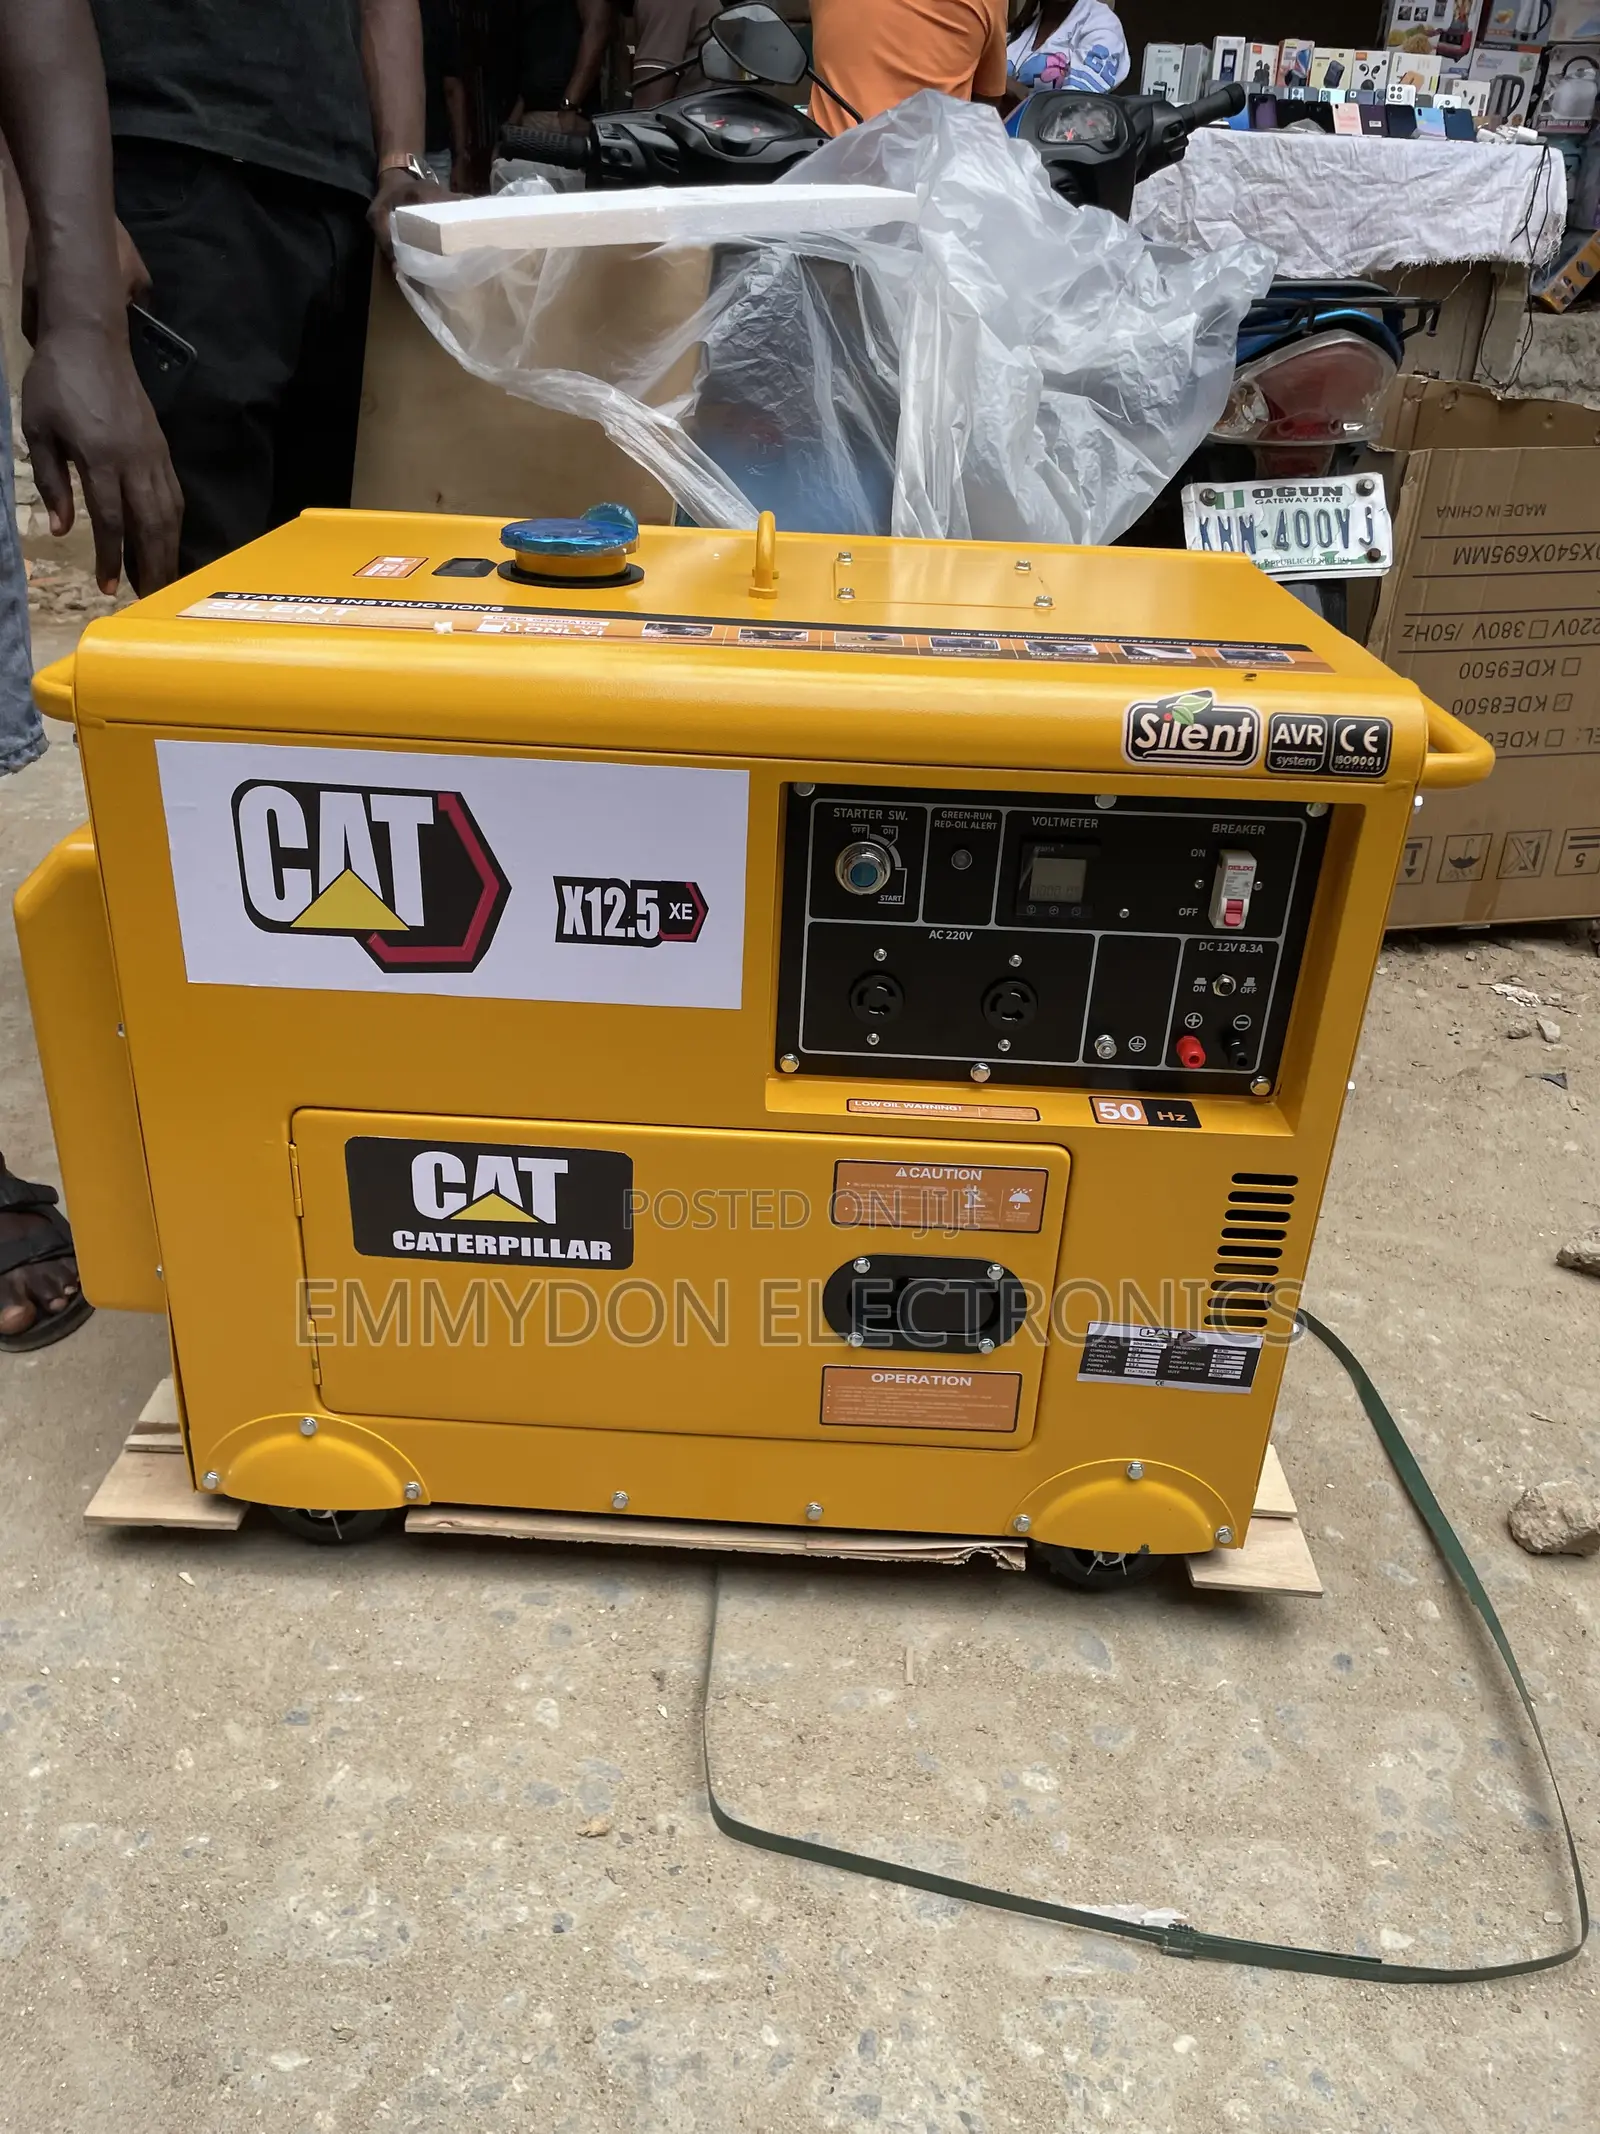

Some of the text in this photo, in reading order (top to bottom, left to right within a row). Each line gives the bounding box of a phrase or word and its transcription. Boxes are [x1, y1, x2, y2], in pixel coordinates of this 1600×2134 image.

[1252, 486, 1343, 498] OGUN
[1254, 496, 1342, 505] GATEWAY STATE
[1436, 504, 1547, 518] MADE IN CHINA
[206, 601, 361, 617] SILENT
[224, 593, 504, 612] STARTING INSTRUCTIONS
[523, 626, 604, 636] ONLY!
[1402, 621, 1464, 643] /50Hz
[1472, 620, 1524, 641] 380V
[1459, 658, 1556, 680] KDE9500
[1451, 693, 1547, 716] KDE8500
[1135, 712, 1253, 752] Silent
[1273, 722, 1323, 747] AVR
[1276, 756, 1316, 768] system
[833, 807, 908, 821] STARTER SW.
[941, 810, 993, 821] GREEN-RUN
[934, 820, 998, 831] RED-OIL ALERT
[1031, 815, 1099, 829] VOLTMETER
[851, 826, 895, 836] OFF ON
[1211, 823, 1266, 836] BREAKER
[238, 784, 435, 928] CAT
[1190, 848, 1206, 858] ON
[1574, 851, 1587, 869] 5
[879, 894, 902, 902] START
[560, 884, 661, 940] X12.5
[668, 901, 694, 920] XE
[1178, 907, 1199, 917] OFF
[929, 930, 973, 942] AC 220V
[1198, 941, 1264, 955] DC 12V 8.3A
[1192, 985, 1206, 993] ON
[1240, 986, 1258, 994] OFF
[854, 1100, 963, 1112] LOW OIL WARNING!
[1098, 1102, 1188, 1122] 50 Hz
[908, 1167, 983, 1181] CAUTION
[411, 1150, 569, 1225] CAT
[392, 1229, 613, 1262] CATERPILLAR
[1139, 1327, 1182, 1340] CAT
[871, 1372, 973, 1387] OPERATION
